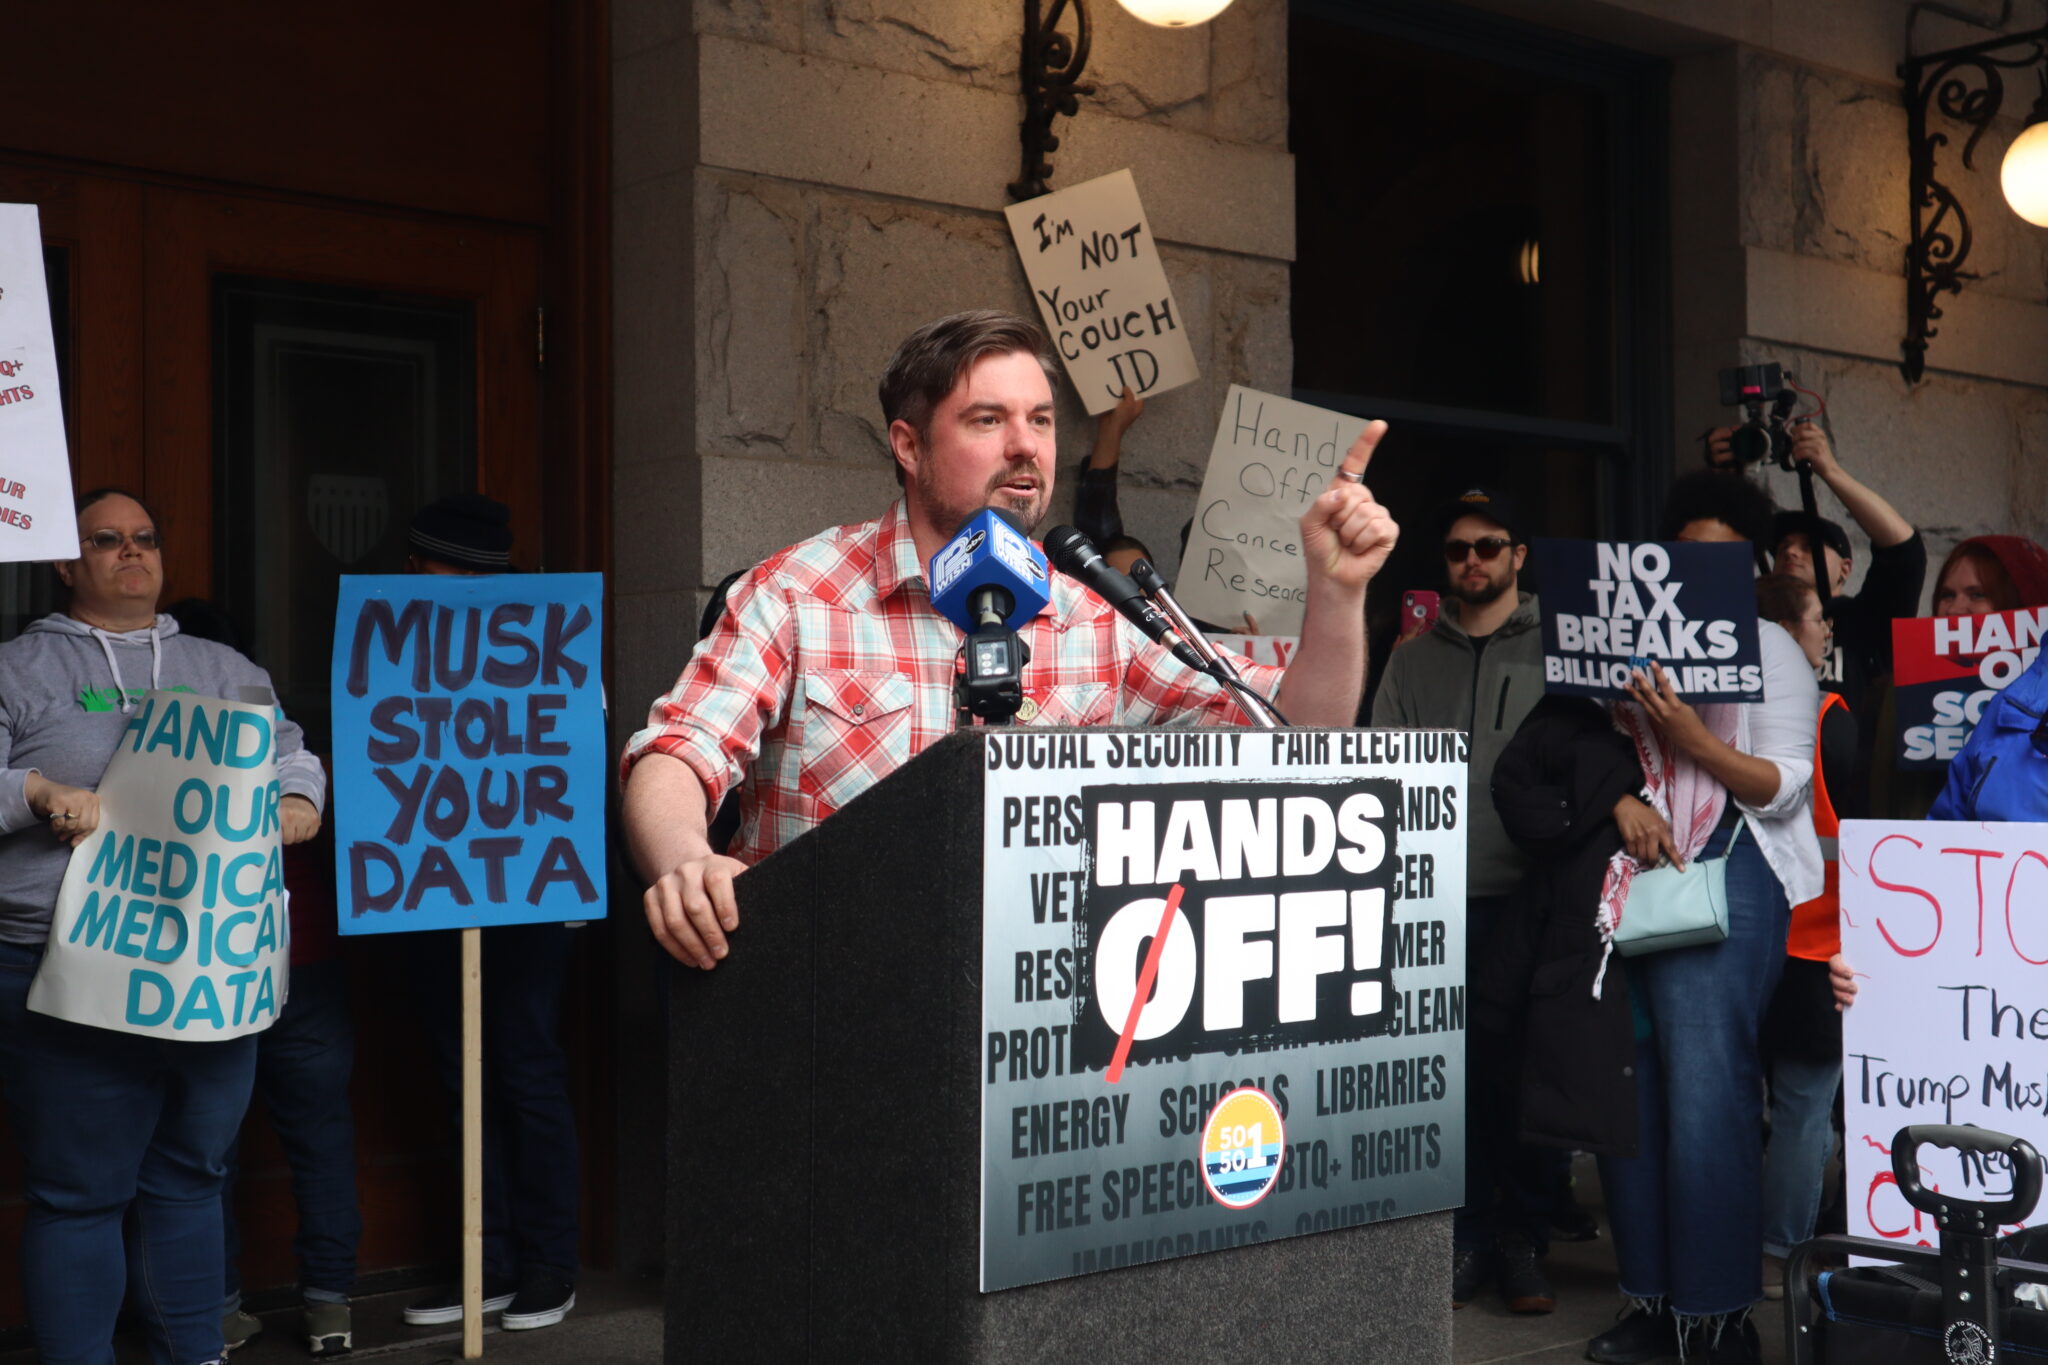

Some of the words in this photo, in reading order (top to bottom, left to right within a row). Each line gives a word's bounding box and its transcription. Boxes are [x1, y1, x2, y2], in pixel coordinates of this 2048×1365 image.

[1081, 222, 1141, 270] NOT
[1038, 285, 1111, 327] Your
[1059, 298, 1176, 361] COUCH
[1105, 349, 1159, 400] JD
[1233, 392, 1353, 467] Hand
[1239, 462, 1323, 503] Off
[936, 559, 971, 592] WISN
[1596, 542, 1671, 582] NO
[1589, 579, 1686, 621] TAX
[346, 598, 593, 699] MUSK
[1556, 613, 1739, 660] BREAKS
[117, 699, 280, 769] HAND
[367, 694, 571, 765] STOLE
[988, 735, 1095, 770] SOCIAL
[1107, 734, 1241, 769] SECURITY
[1272, 733, 1330, 766] FAIR
[1341, 733, 1468, 764] ELECTIONS
[1903, 726, 1974, 761] SE
[173, 777, 280, 842] OUR
[373, 764, 574, 845] YOUR
[87, 830, 283, 908] MEDICA
[1096, 792, 1386, 886] HANDS
[348, 836, 600, 918] DATA
[69, 890, 285, 967] MEDICA
[1094, 887, 1386, 1041] OFF!
[125, 966, 275, 1031] DATA
[1389, 985, 1465, 1038] CLEAN
[1012, 1093, 1130, 1160] ENERGY
[1316, 1054, 1446, 1117] LIBRARIES
[1848, 1053, 1970, 1125] Trump
[1982, 1061, 2048, 1117] Mus
[1017, 1174, 1091, 1236] FREE
[1351, 1122, 1441, 1181] RIGHTS
[1966, 1322, 1988, 1339] MARCH
